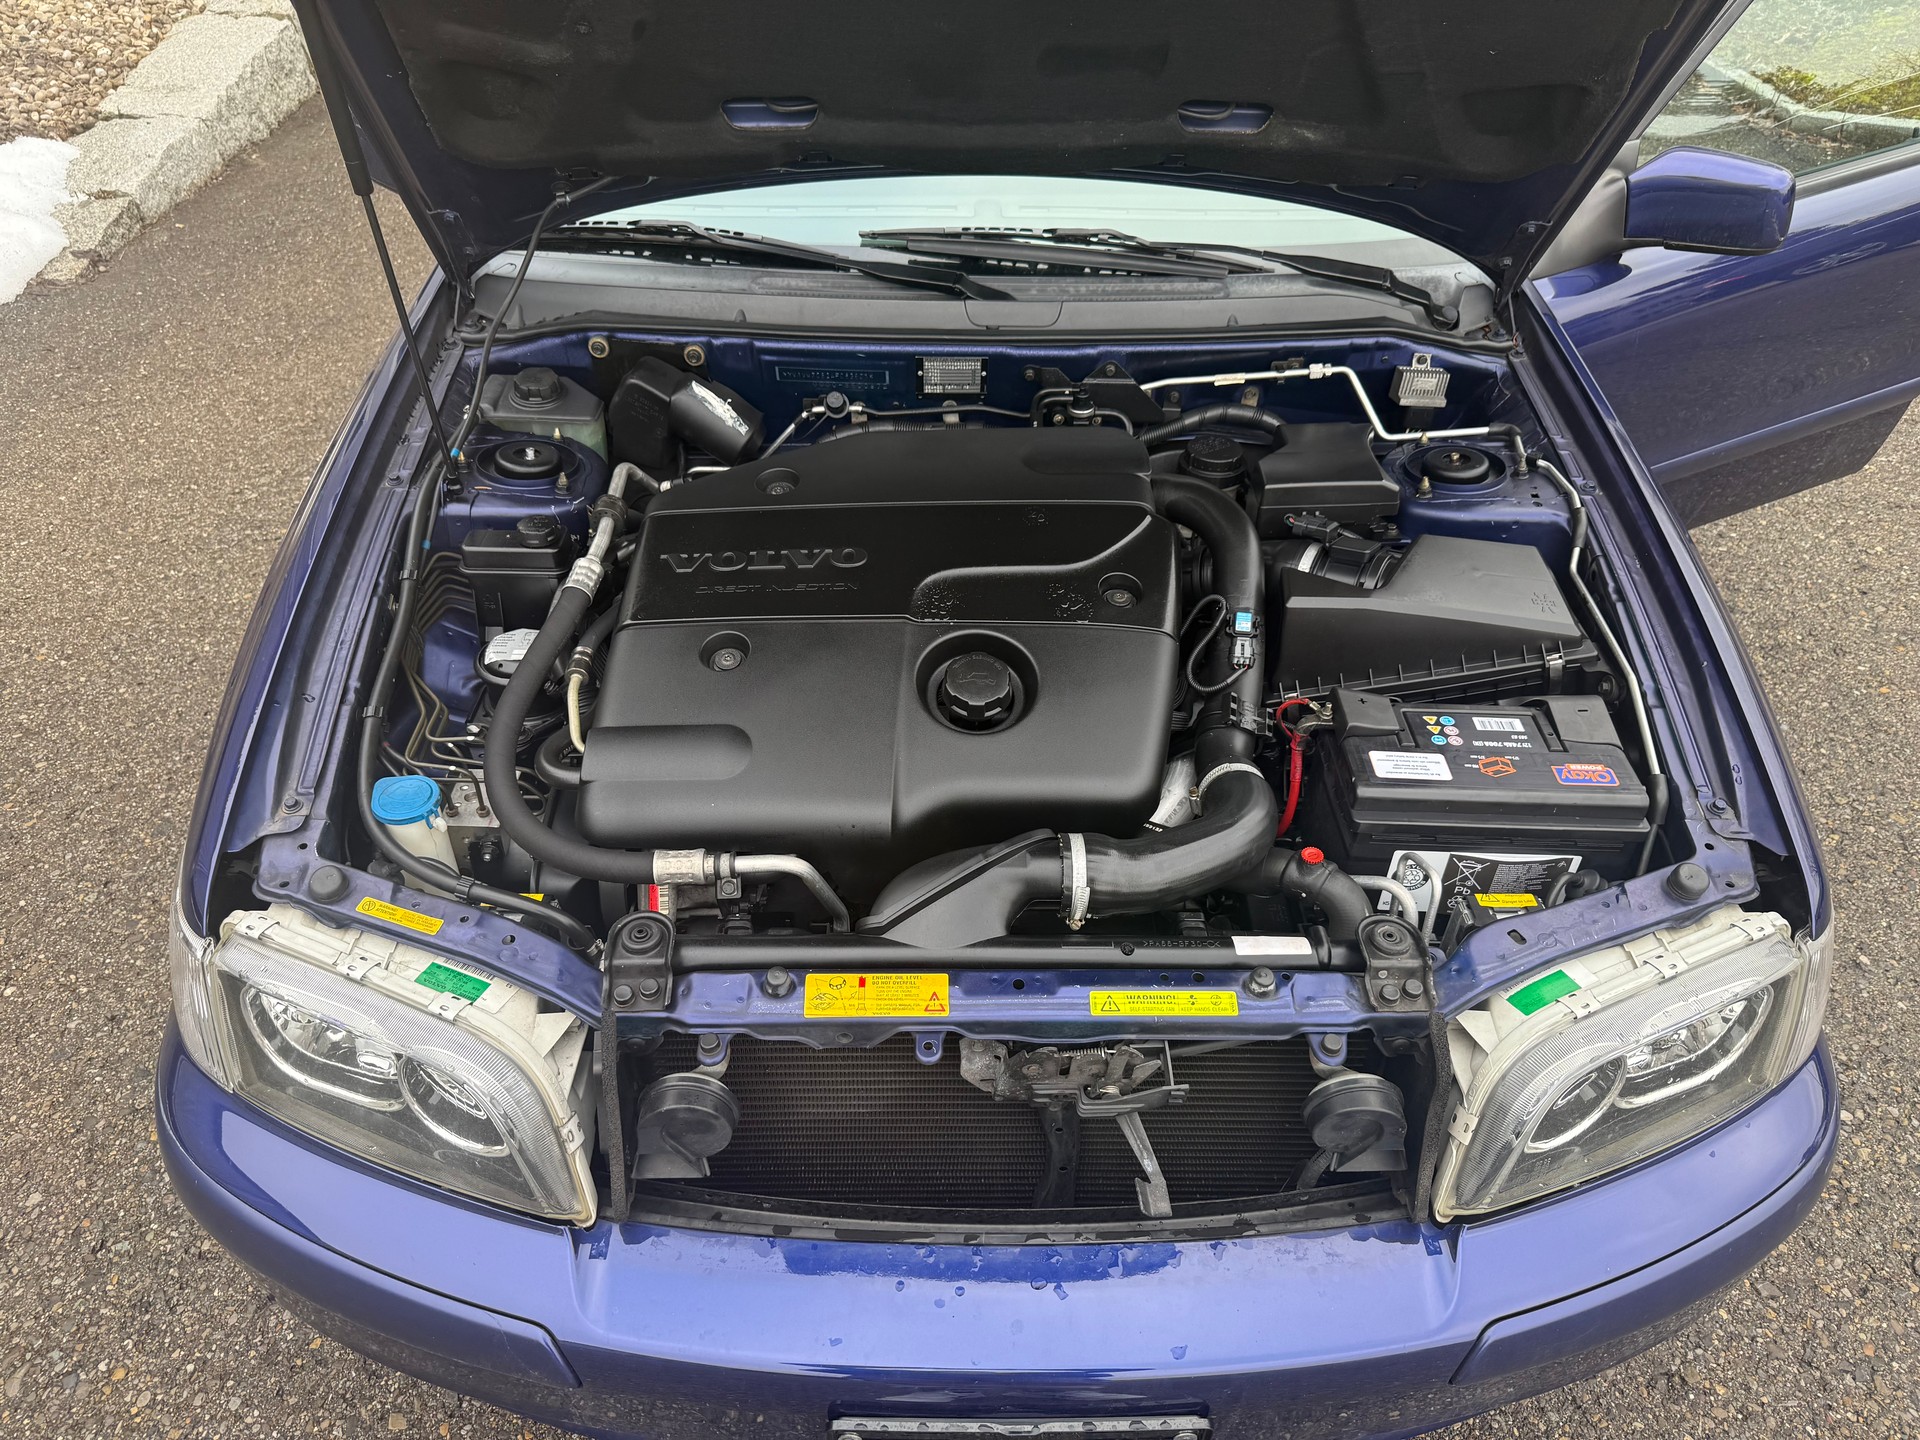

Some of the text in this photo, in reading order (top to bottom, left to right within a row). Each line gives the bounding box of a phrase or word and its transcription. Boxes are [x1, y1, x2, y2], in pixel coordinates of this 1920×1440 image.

[659, 547, 869, 573] VOLVO
[695, 581, 859, 595] DIRECT INJECTION
[1561, 769, 1611, 783] Okay
[1454, 886, 1471, 895] Pb
[423, 978, 447, 990] VOLVO
[1126, 994, 1176, 1004] WARNING!
